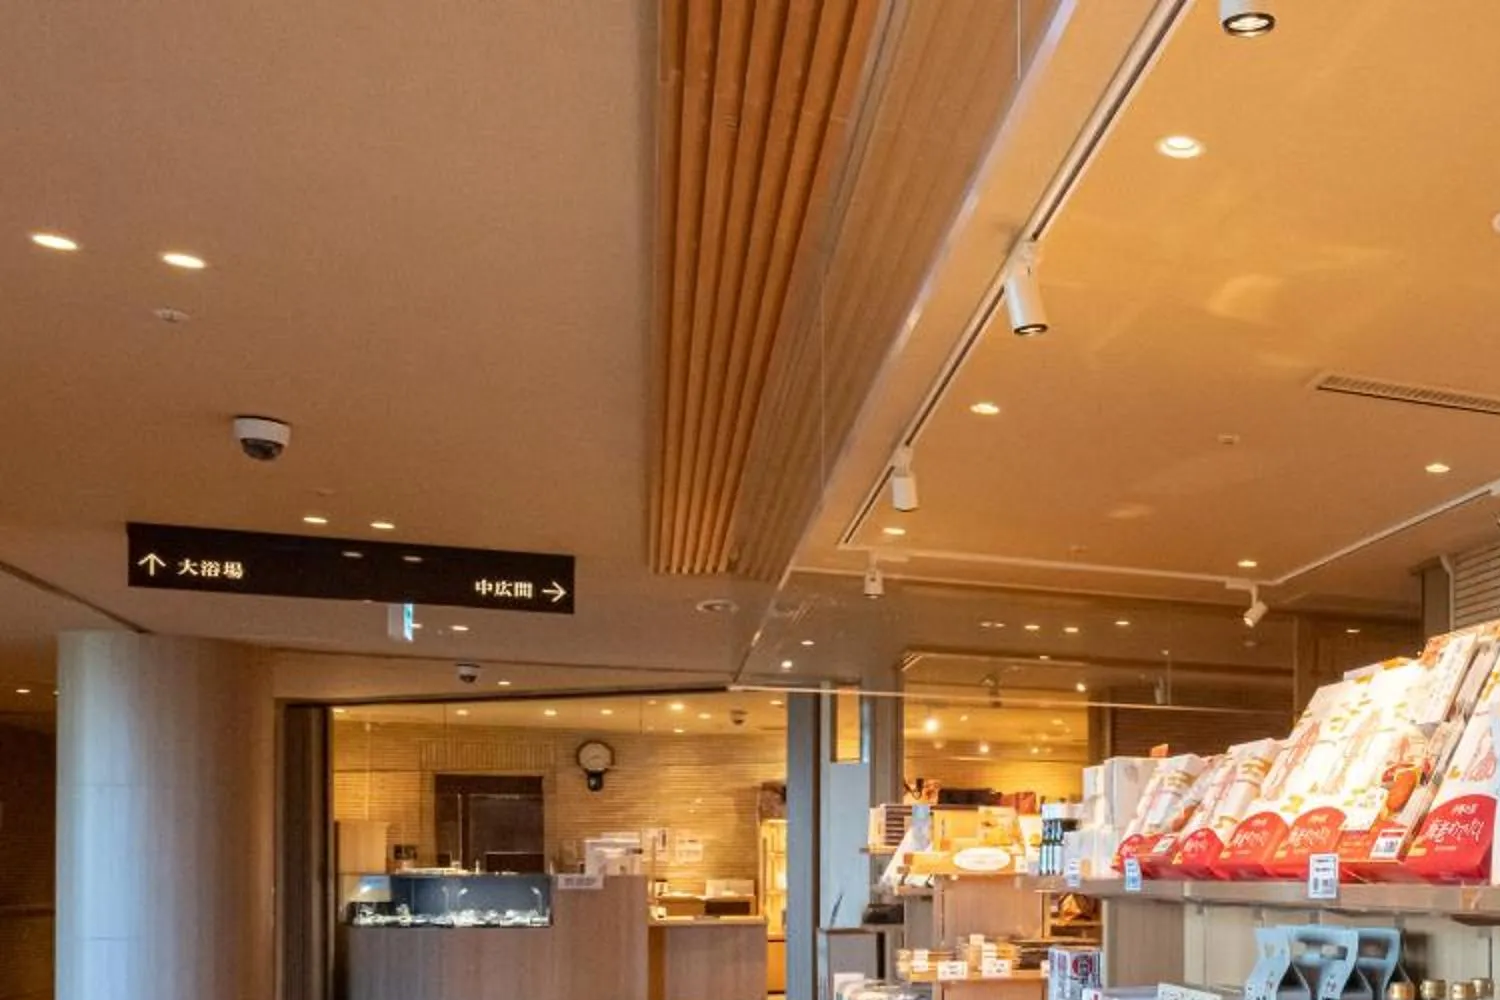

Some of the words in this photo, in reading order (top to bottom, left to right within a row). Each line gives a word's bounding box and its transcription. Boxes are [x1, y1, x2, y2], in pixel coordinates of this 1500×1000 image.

[177, 558, 243, 579] 大浴場
[475, 579, 533, 599] 中広間
